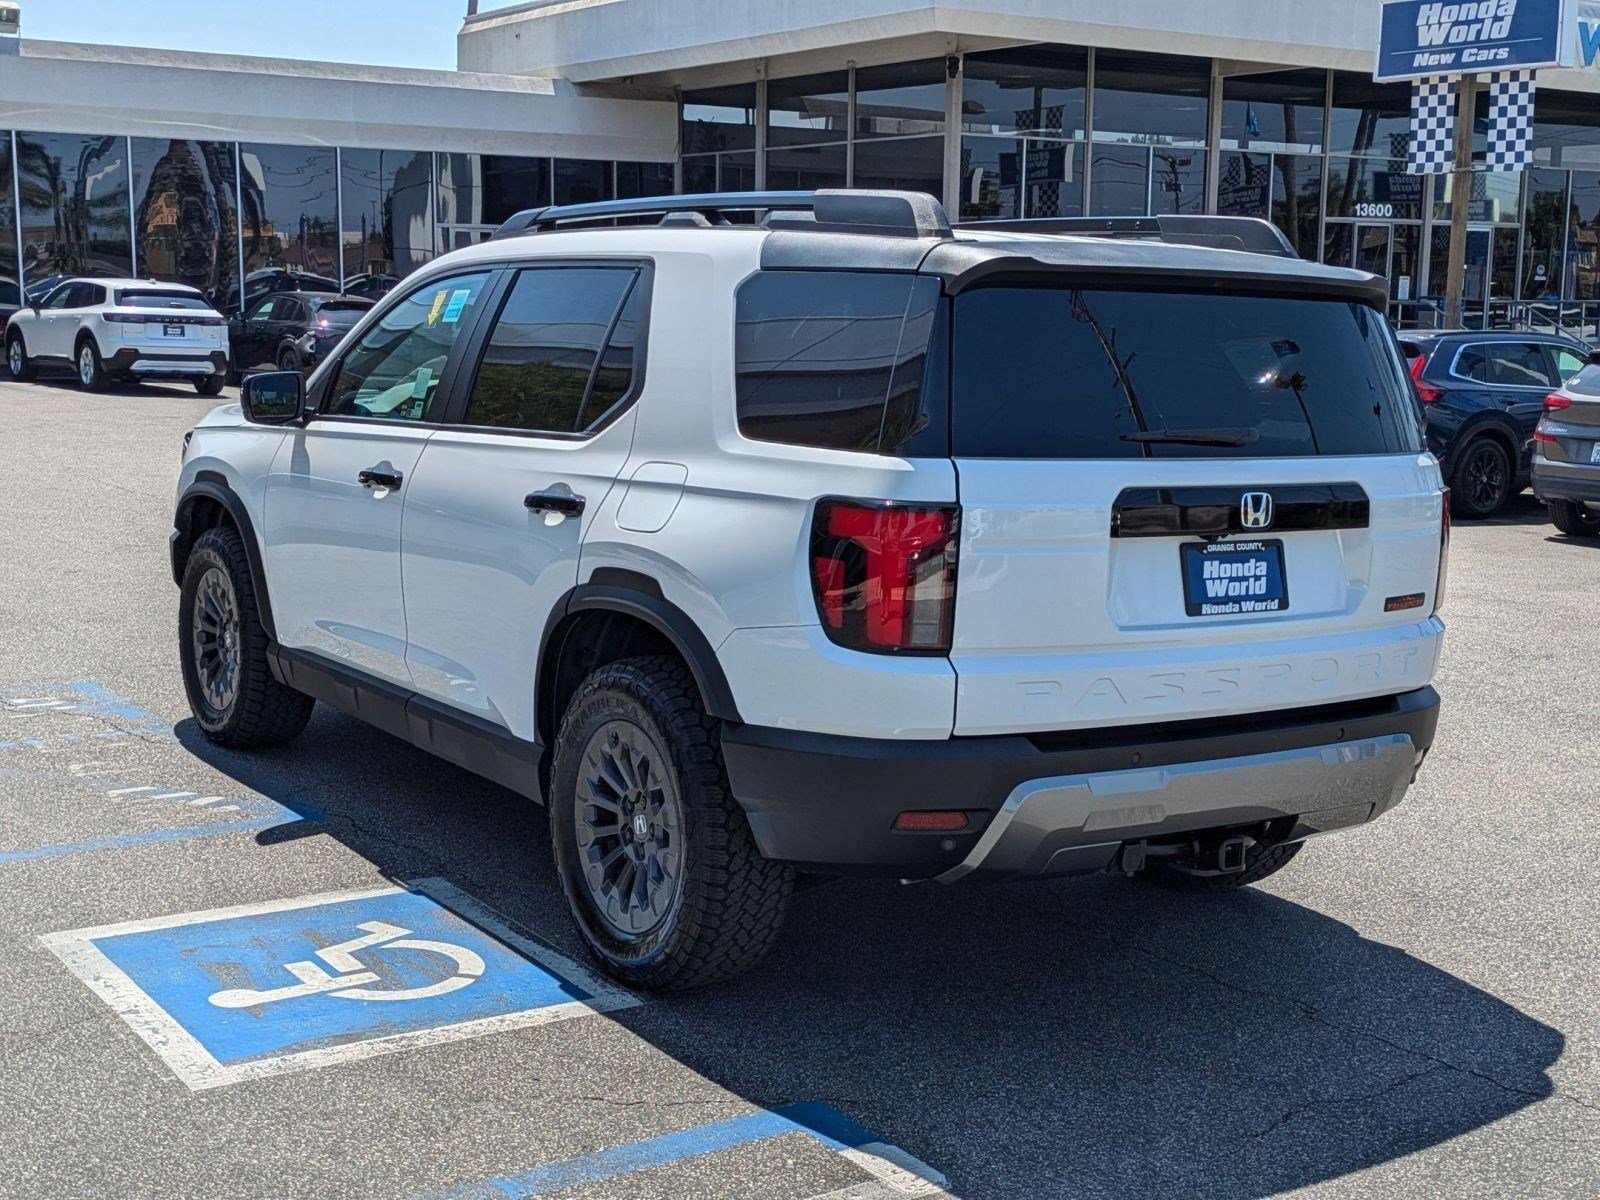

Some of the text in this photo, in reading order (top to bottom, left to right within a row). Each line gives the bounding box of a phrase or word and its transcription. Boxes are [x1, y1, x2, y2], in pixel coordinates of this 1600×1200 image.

[1416, 0, 1517, 26] Honda
[1417, 15, 1513, 47] World
[1413, 47, 1509, 67] New Cars
[1355, 203, 1393, 217] 13600
[1207, 542, 1263, 552] ORANGE COUNTY
[1203, 559, 1267, 579] Honda
[1205, 577, 1267, 598] World
[1201, 599, 1279, 615] Honda World
[1014, 647, 1420, 708] PASSPORT
